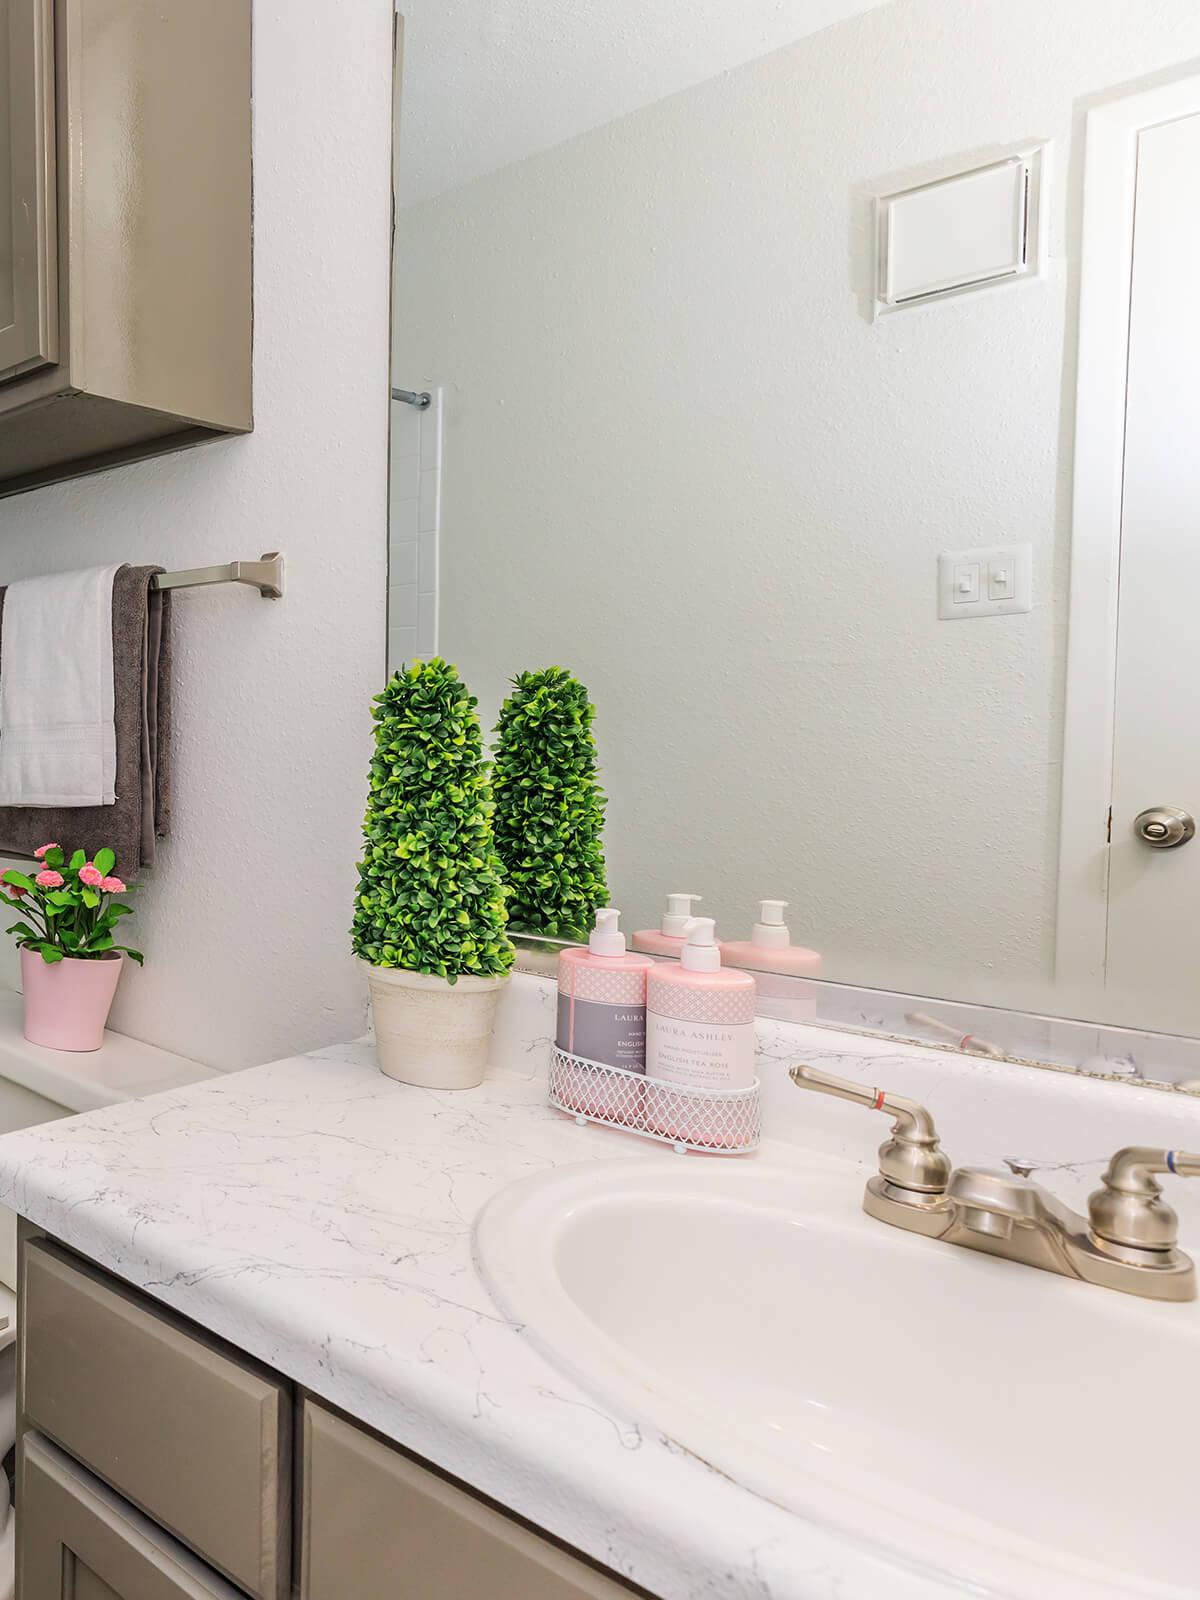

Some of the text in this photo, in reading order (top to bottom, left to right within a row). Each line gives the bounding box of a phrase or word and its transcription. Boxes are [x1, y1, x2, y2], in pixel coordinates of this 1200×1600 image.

[614, 1014, 644, 1022] LAURA
[655, 1023, 686, 1037] LAURA
[690, 1031, 734, 1041] ASHLEY
[658, 1051, 689, 1064] ENGLISH
[691, 1059, 706, 1067] TEA
